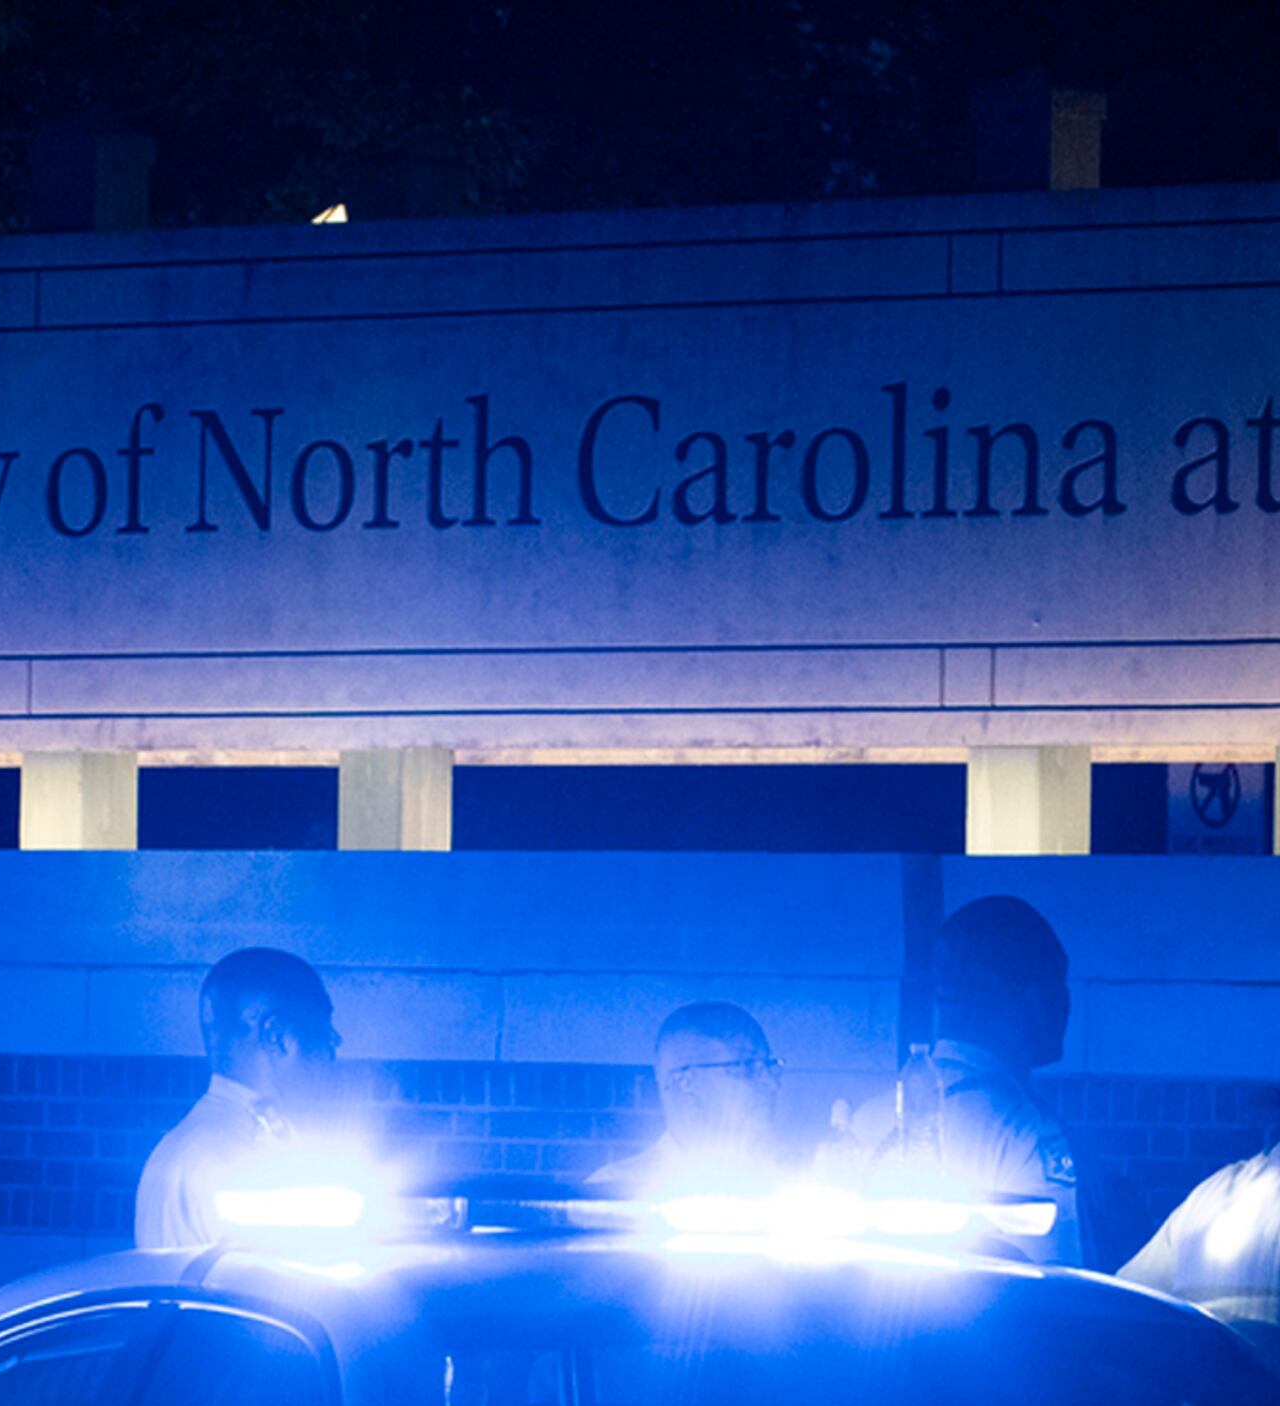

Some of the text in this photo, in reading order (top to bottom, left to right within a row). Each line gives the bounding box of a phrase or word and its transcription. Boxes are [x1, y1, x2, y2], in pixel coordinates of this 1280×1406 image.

[45, 402, 164, 537] of
[185, 393, 542, 534] North
[576, 381, 1127, 528] Carolina
